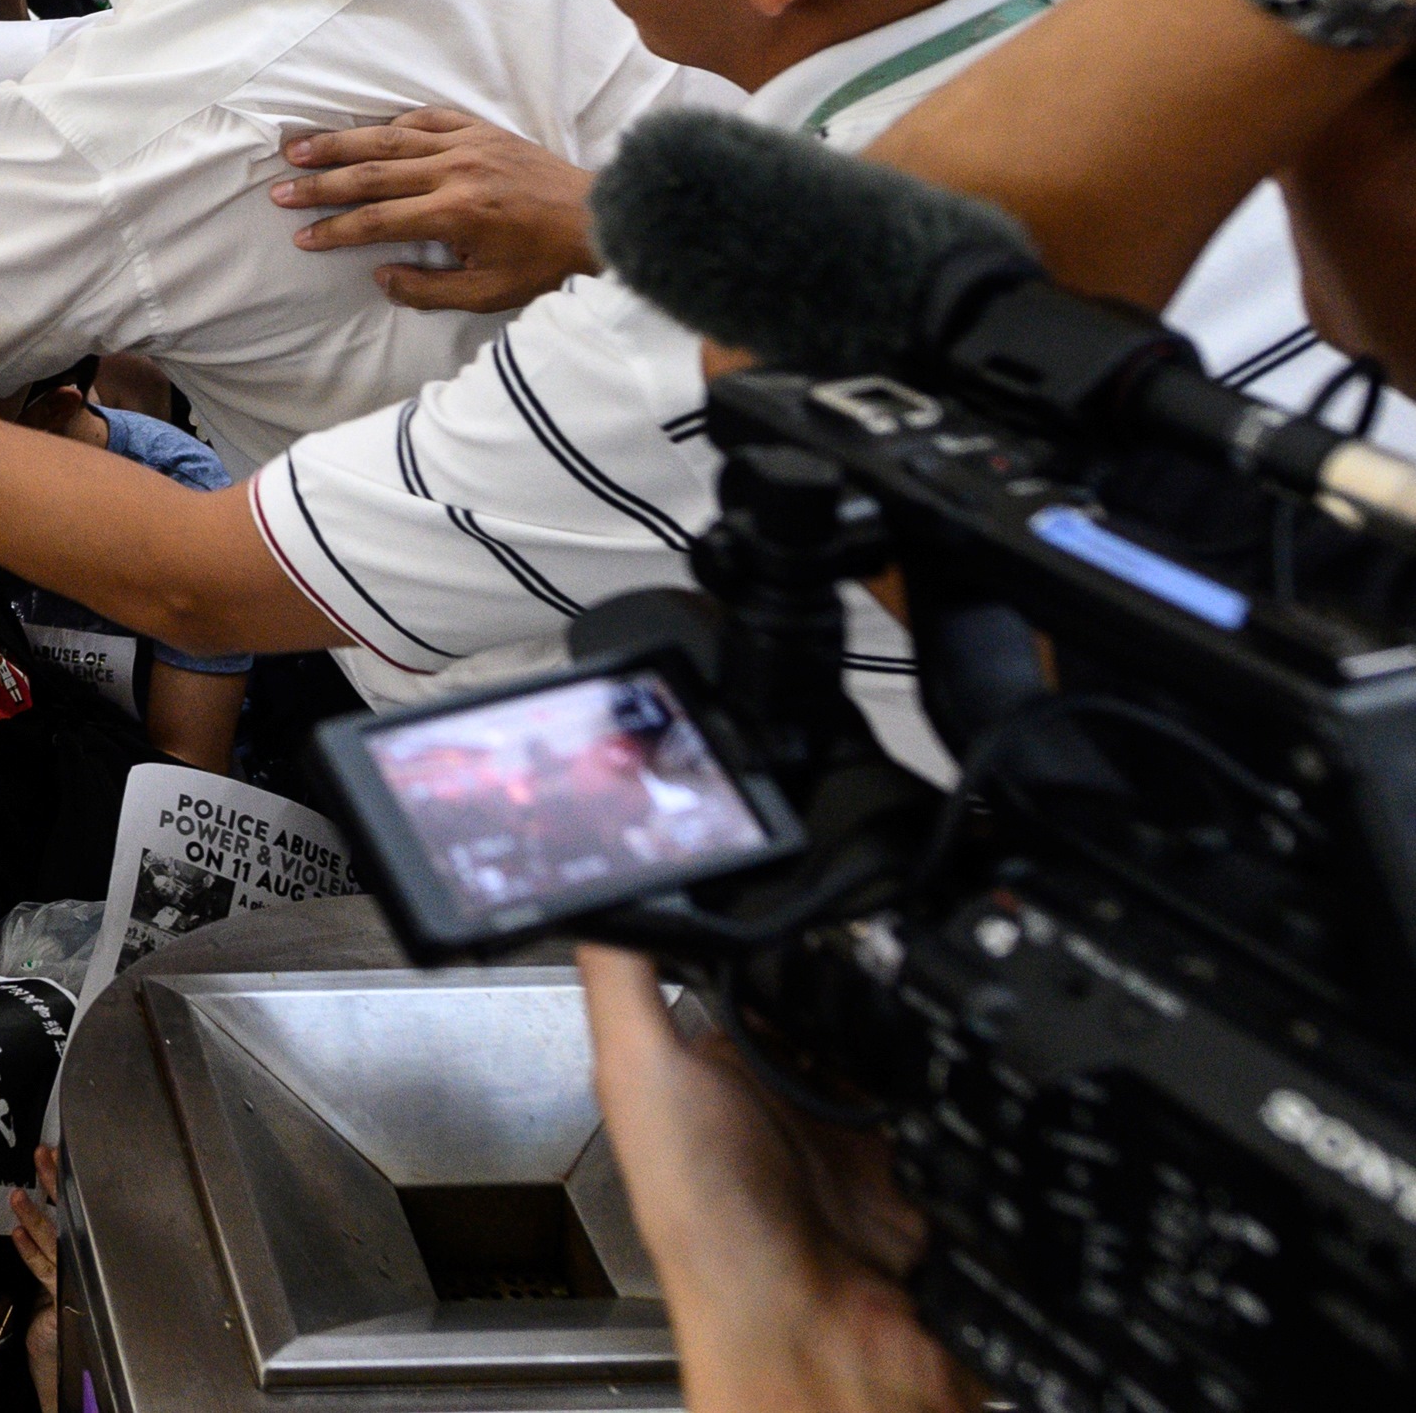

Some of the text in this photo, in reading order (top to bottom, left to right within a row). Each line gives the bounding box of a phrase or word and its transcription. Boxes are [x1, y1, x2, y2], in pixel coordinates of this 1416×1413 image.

[84, 651, 107, 667] OF
[159, 809, 250, 858] POWER
[256, 845, 271, 867] &
[177, 793, 270, 843] POLICE
[272, 829, 341, 876] ABUSE
[185, 841, 307, 902] ON 11 AUG
